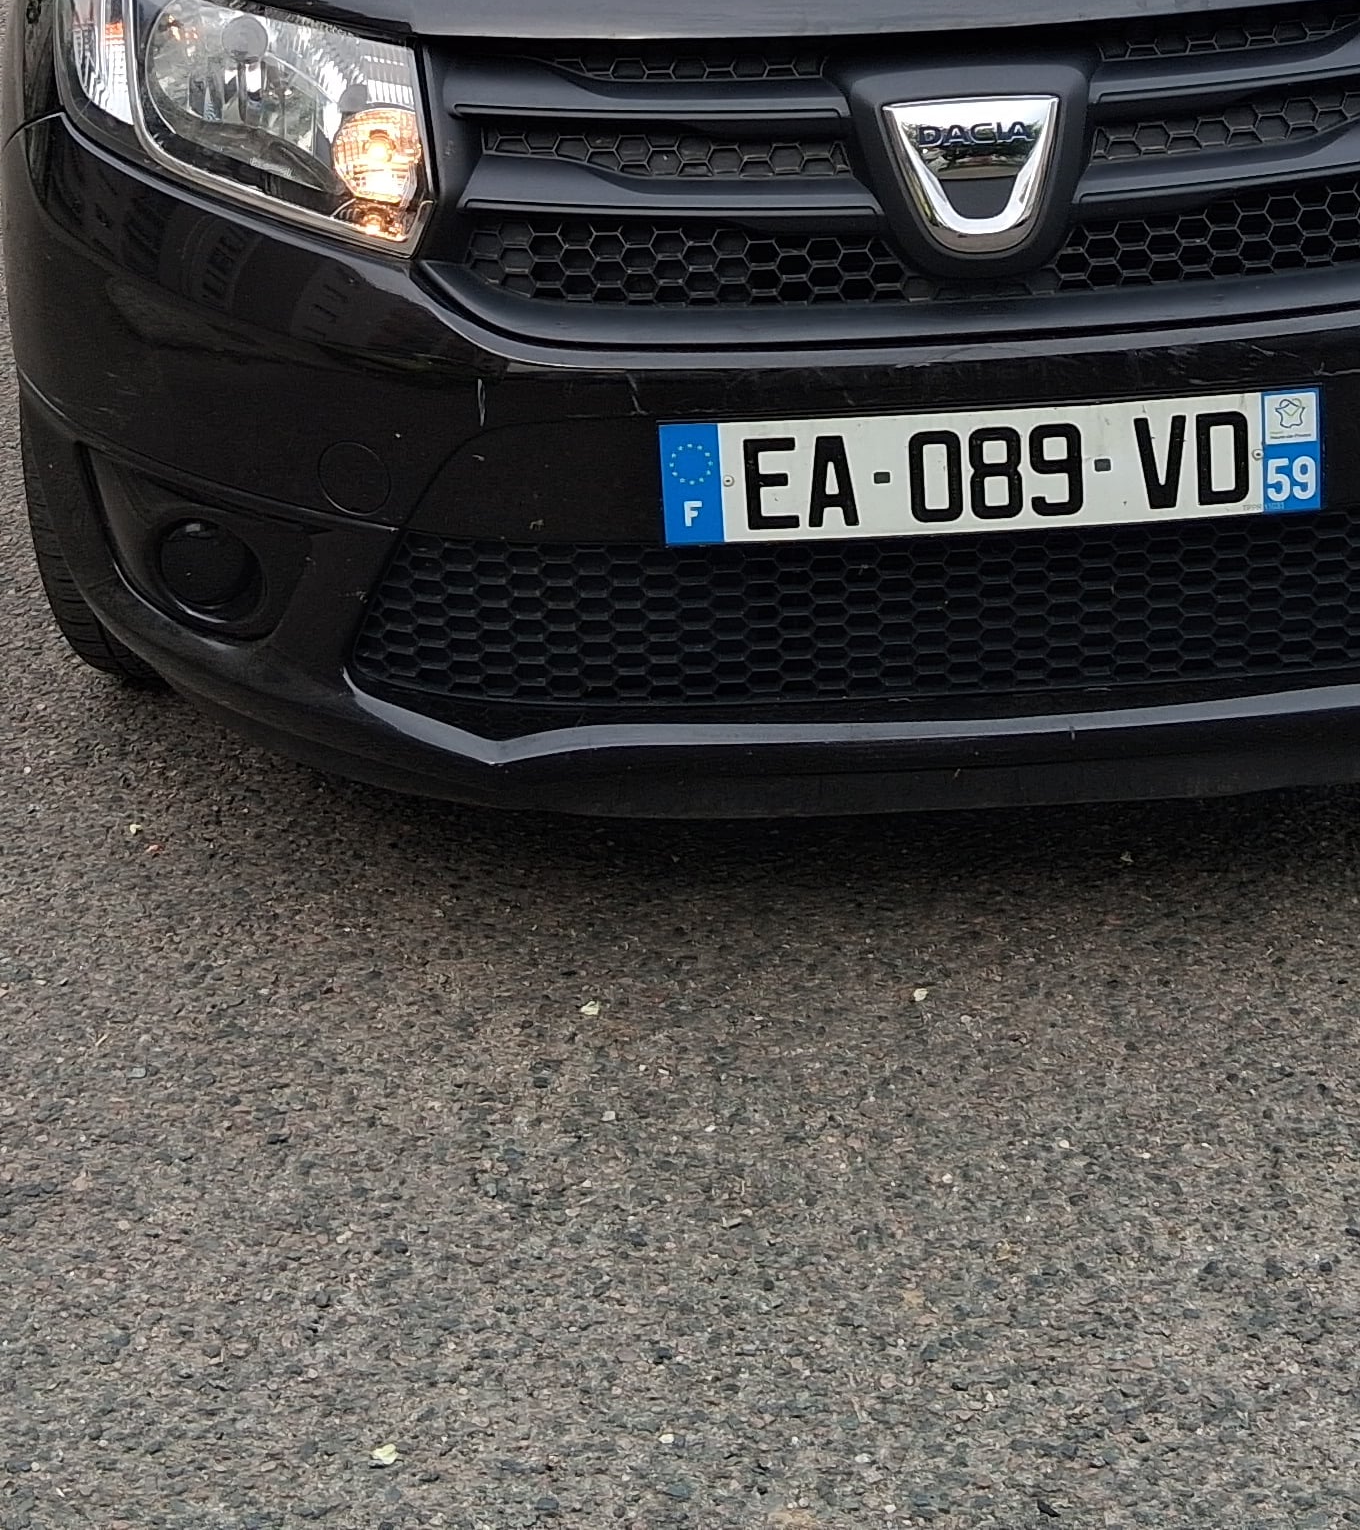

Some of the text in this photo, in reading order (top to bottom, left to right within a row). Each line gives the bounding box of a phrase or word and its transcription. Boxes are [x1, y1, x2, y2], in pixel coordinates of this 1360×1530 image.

[919, 121, 1033, 147] DACIA
[1267, 455, 1316, 502] 59
[683, 500, 700, 528] F
